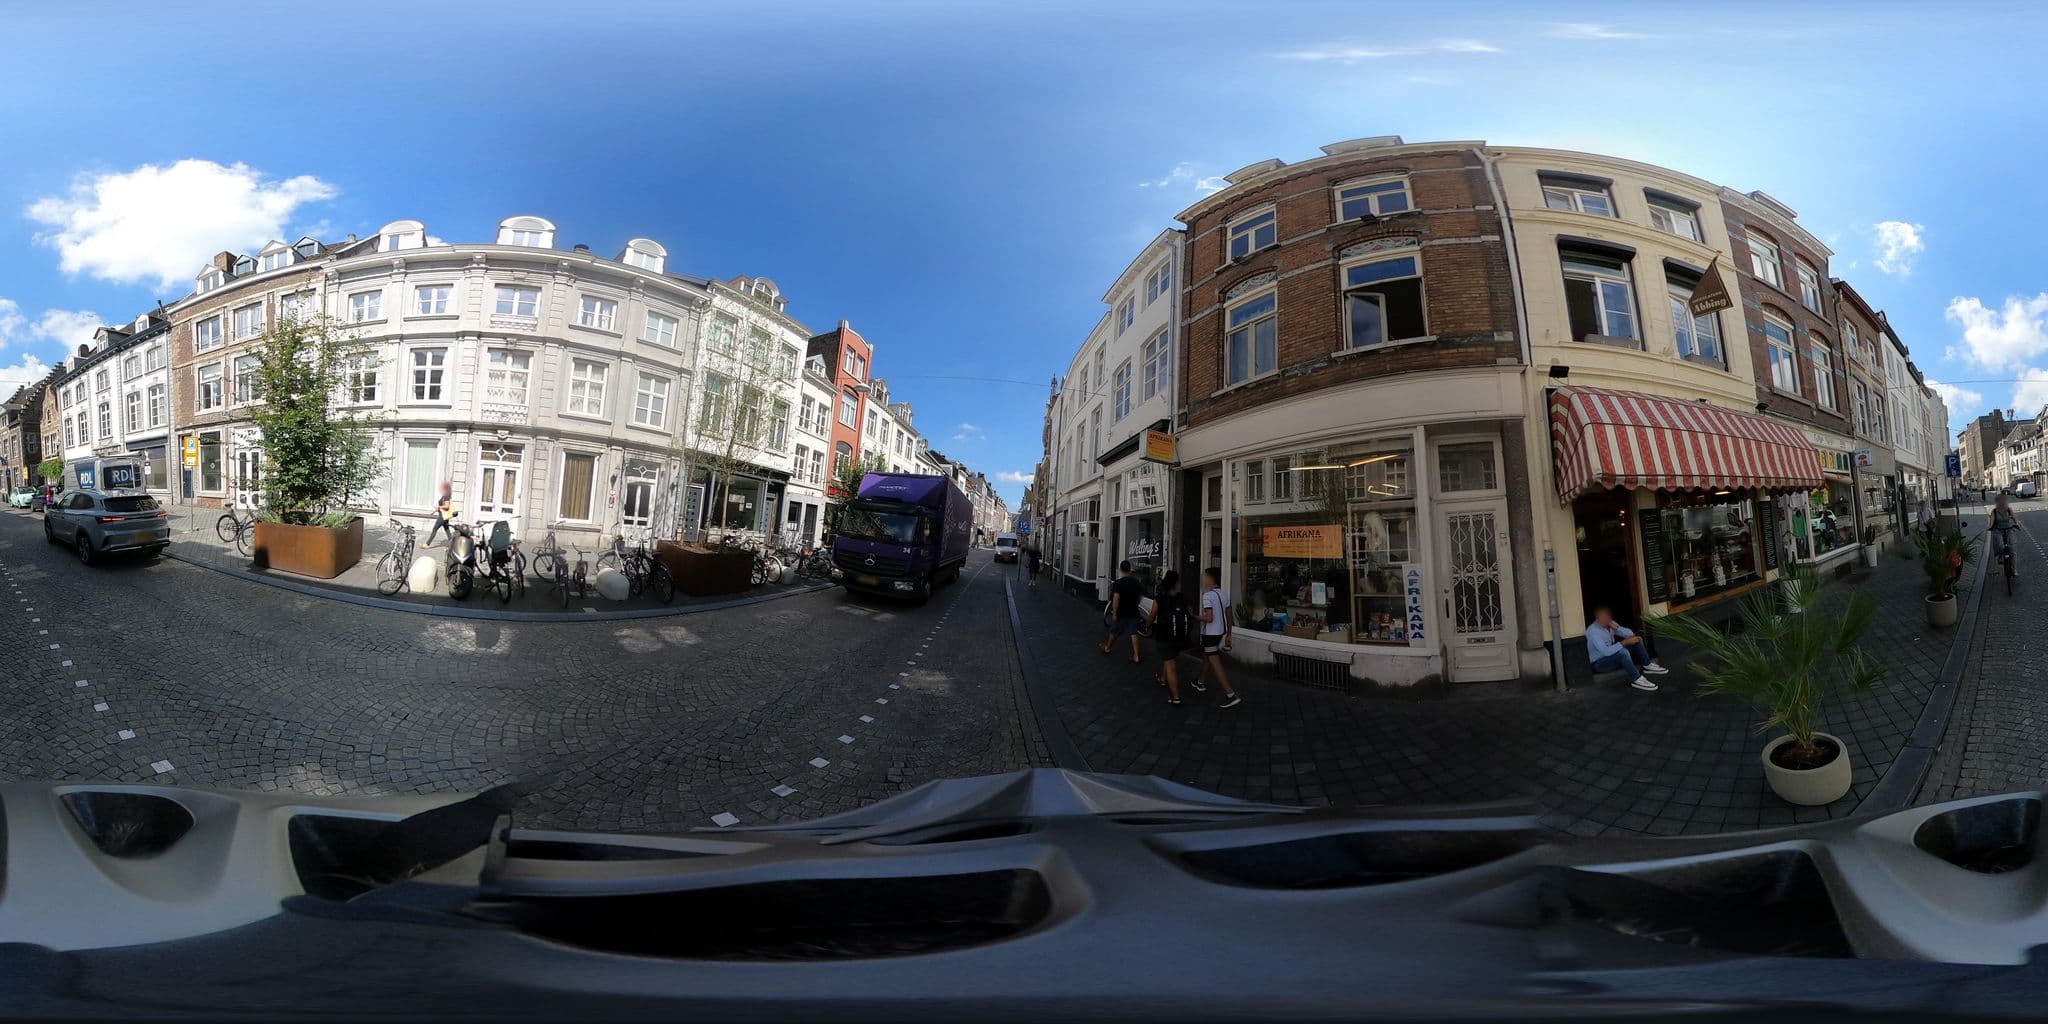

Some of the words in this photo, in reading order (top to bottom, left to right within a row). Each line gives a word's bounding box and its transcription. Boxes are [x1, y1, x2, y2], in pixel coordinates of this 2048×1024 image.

[1694, 298, 1727, 313] Abbing
[1949, 457, 1957, 466] P
[80, 472, 93, 485] RDL
[112, 469, 134, 483] RDL
[1278, 529, 1322, 539] AFRIKANA
[1407, 569, 1424, 639] AFRIKANA
